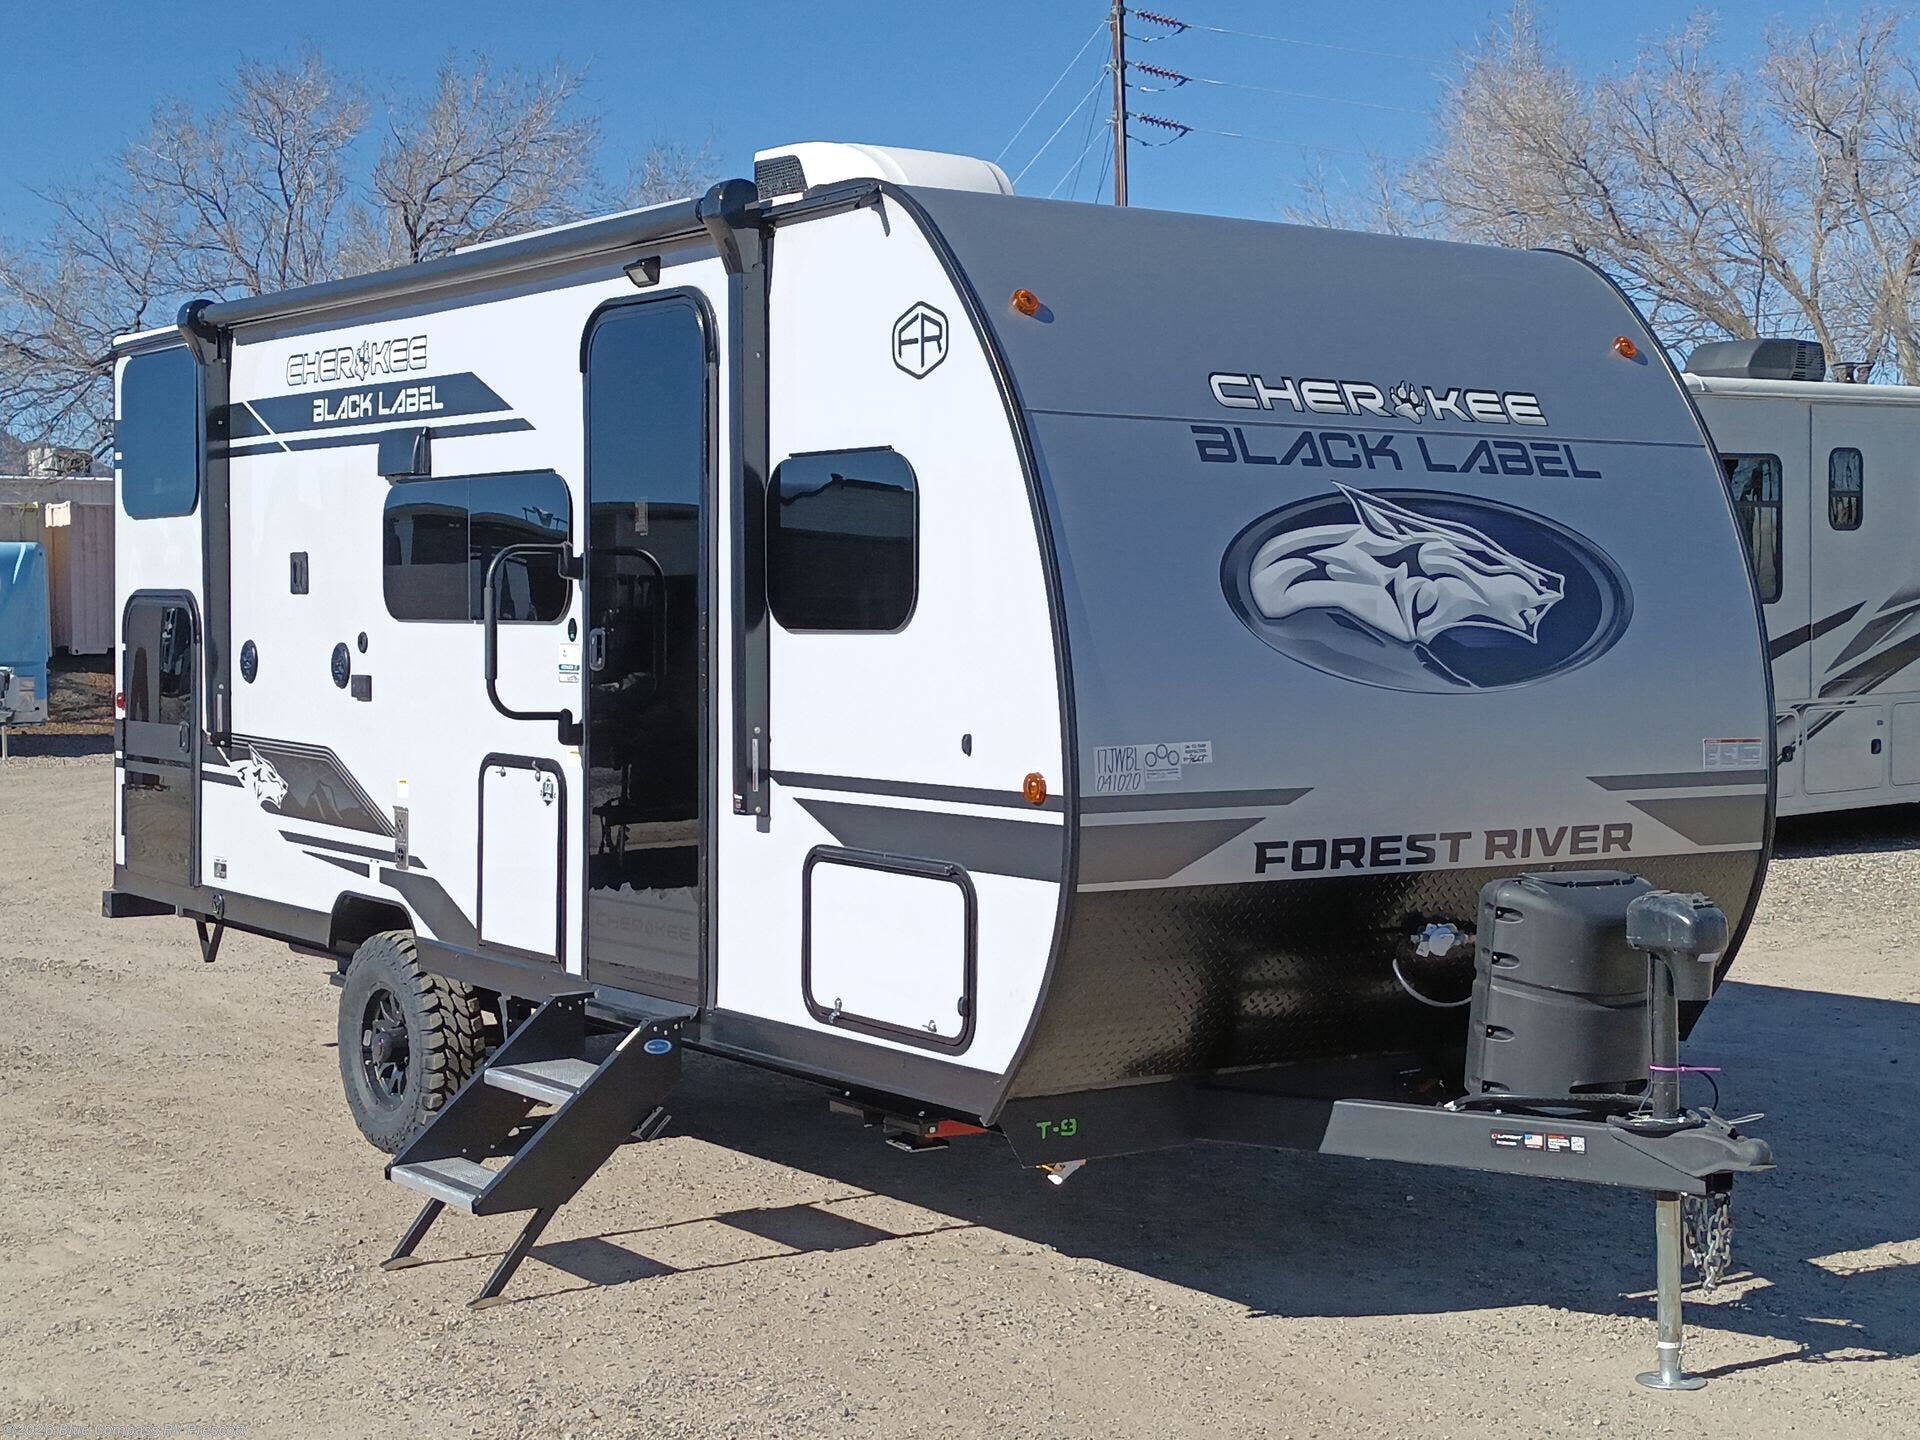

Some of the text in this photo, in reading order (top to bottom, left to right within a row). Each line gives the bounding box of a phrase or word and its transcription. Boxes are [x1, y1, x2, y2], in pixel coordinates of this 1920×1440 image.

[898, 312, 943, 368] FR
[313, 385, 444, 422] BLACK LABEL
[1190, 425, 1602, 479] BLACK LABEL
[1254, 822, 1633, 874] FOREST RIVER
